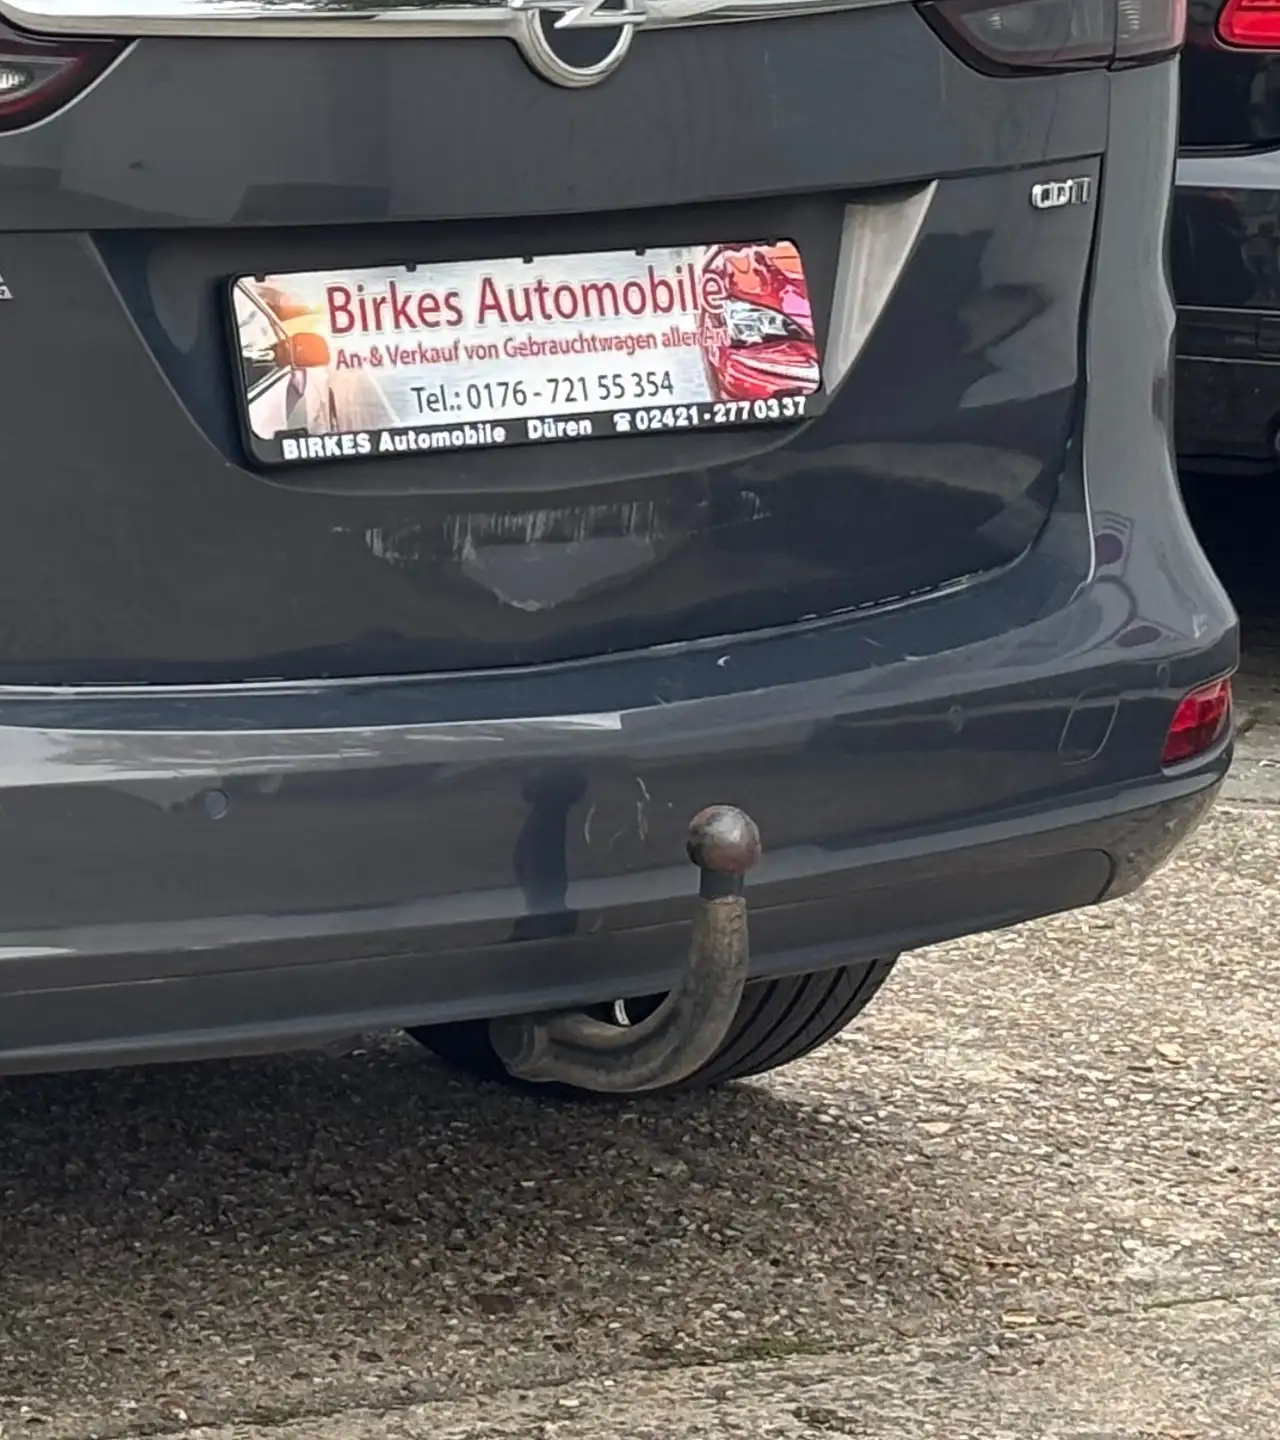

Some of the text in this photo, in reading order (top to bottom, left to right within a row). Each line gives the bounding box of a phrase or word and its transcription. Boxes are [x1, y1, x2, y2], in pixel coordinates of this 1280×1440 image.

[326, 262, 726, 335] Birkes Automobile
[385, 337, 461, 366] Verkauf
[464, 342, 500, 361] von
[503, 329, 657, 358] Gebrauchtwagen
[661, 325, 701, 347] aller
[467, 380, 527, 410] 0176
[546, 375, 589, 405] 721
[597, 373, 627, 401] 55
[631, 369, 676, 399] 354
[282, 433, 371, 460] BIRKES
[378, 422, 507, 453] Automobile
[526, 416, 593, 440] Düren
